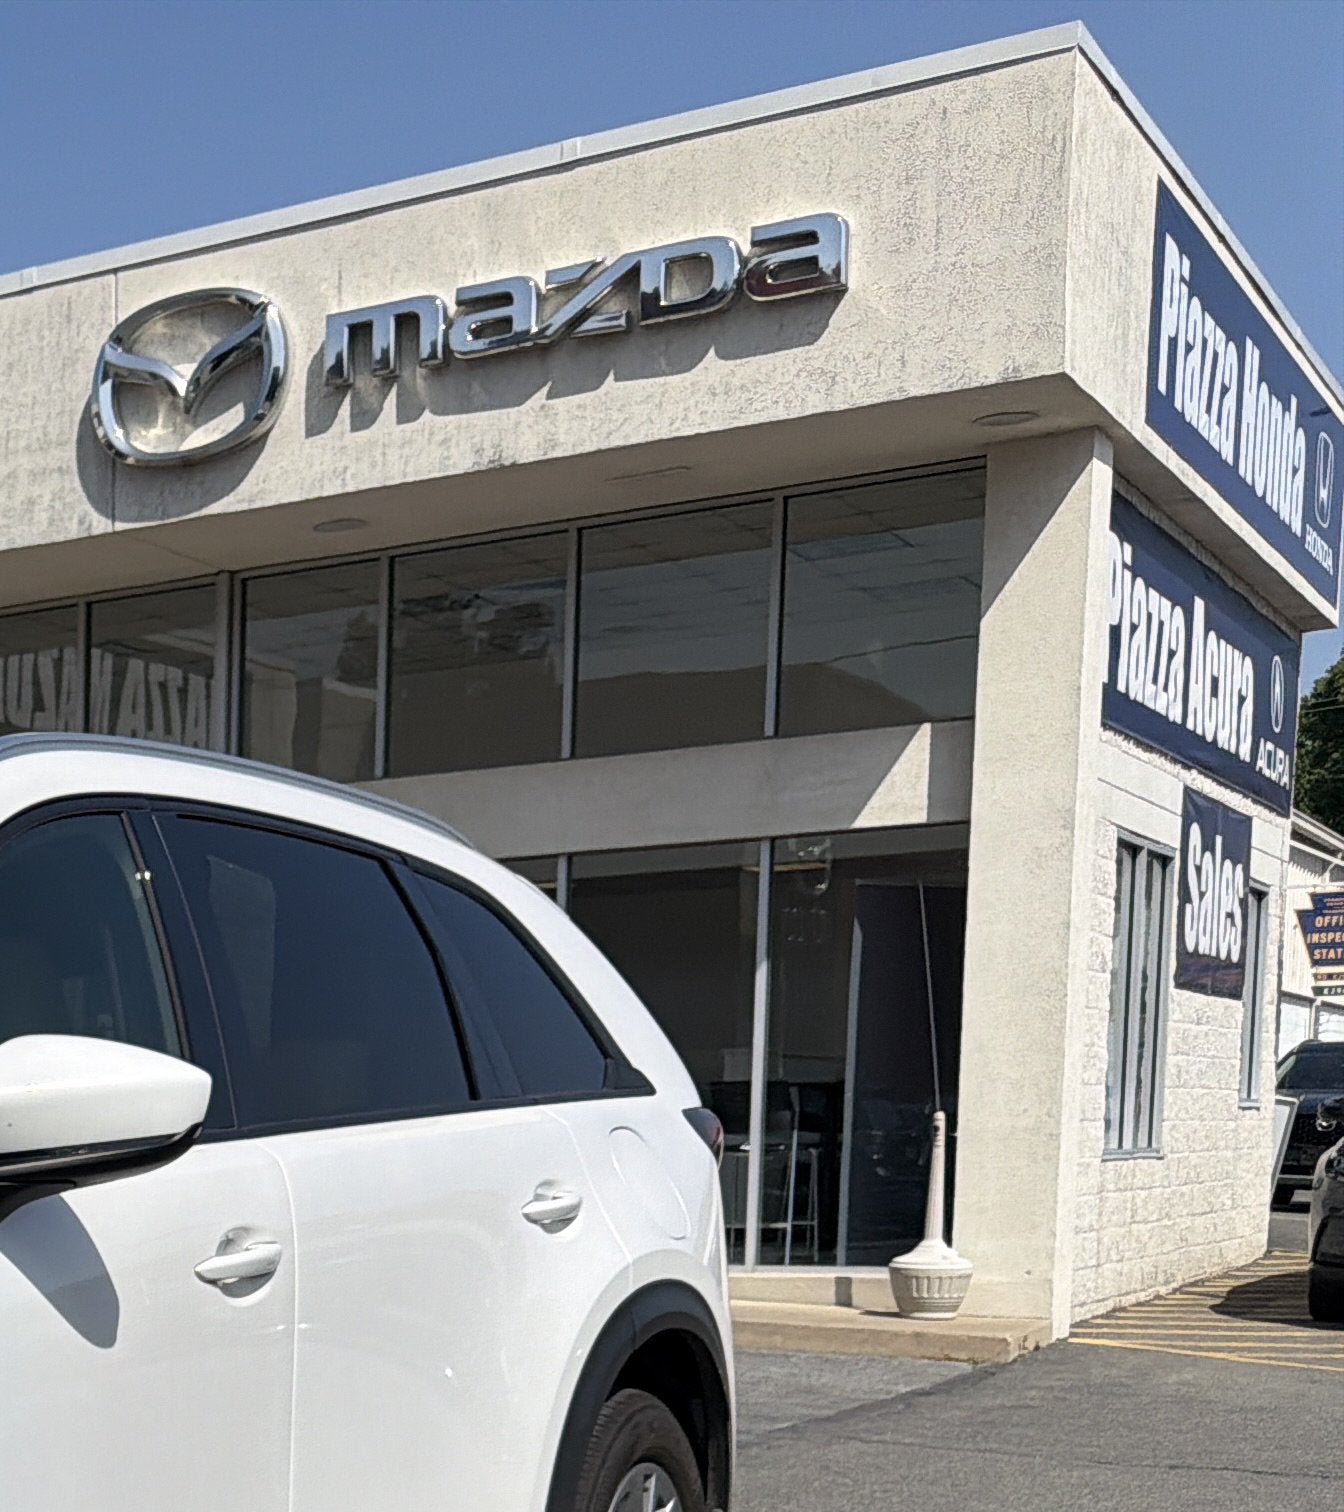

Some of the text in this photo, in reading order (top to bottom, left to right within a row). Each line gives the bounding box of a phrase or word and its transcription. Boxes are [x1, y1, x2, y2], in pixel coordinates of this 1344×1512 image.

[323, 211, 850, 389] mazda
[1157, 231, 1307, 538] Piazza Honda
[1304, 522, 1334, 576] HONDA
[1102, 529, 1255, 764] Piazza Acura
[1255, 736, 1291, 788] ACURA
[1184, 821, 1245, 965] Sales
